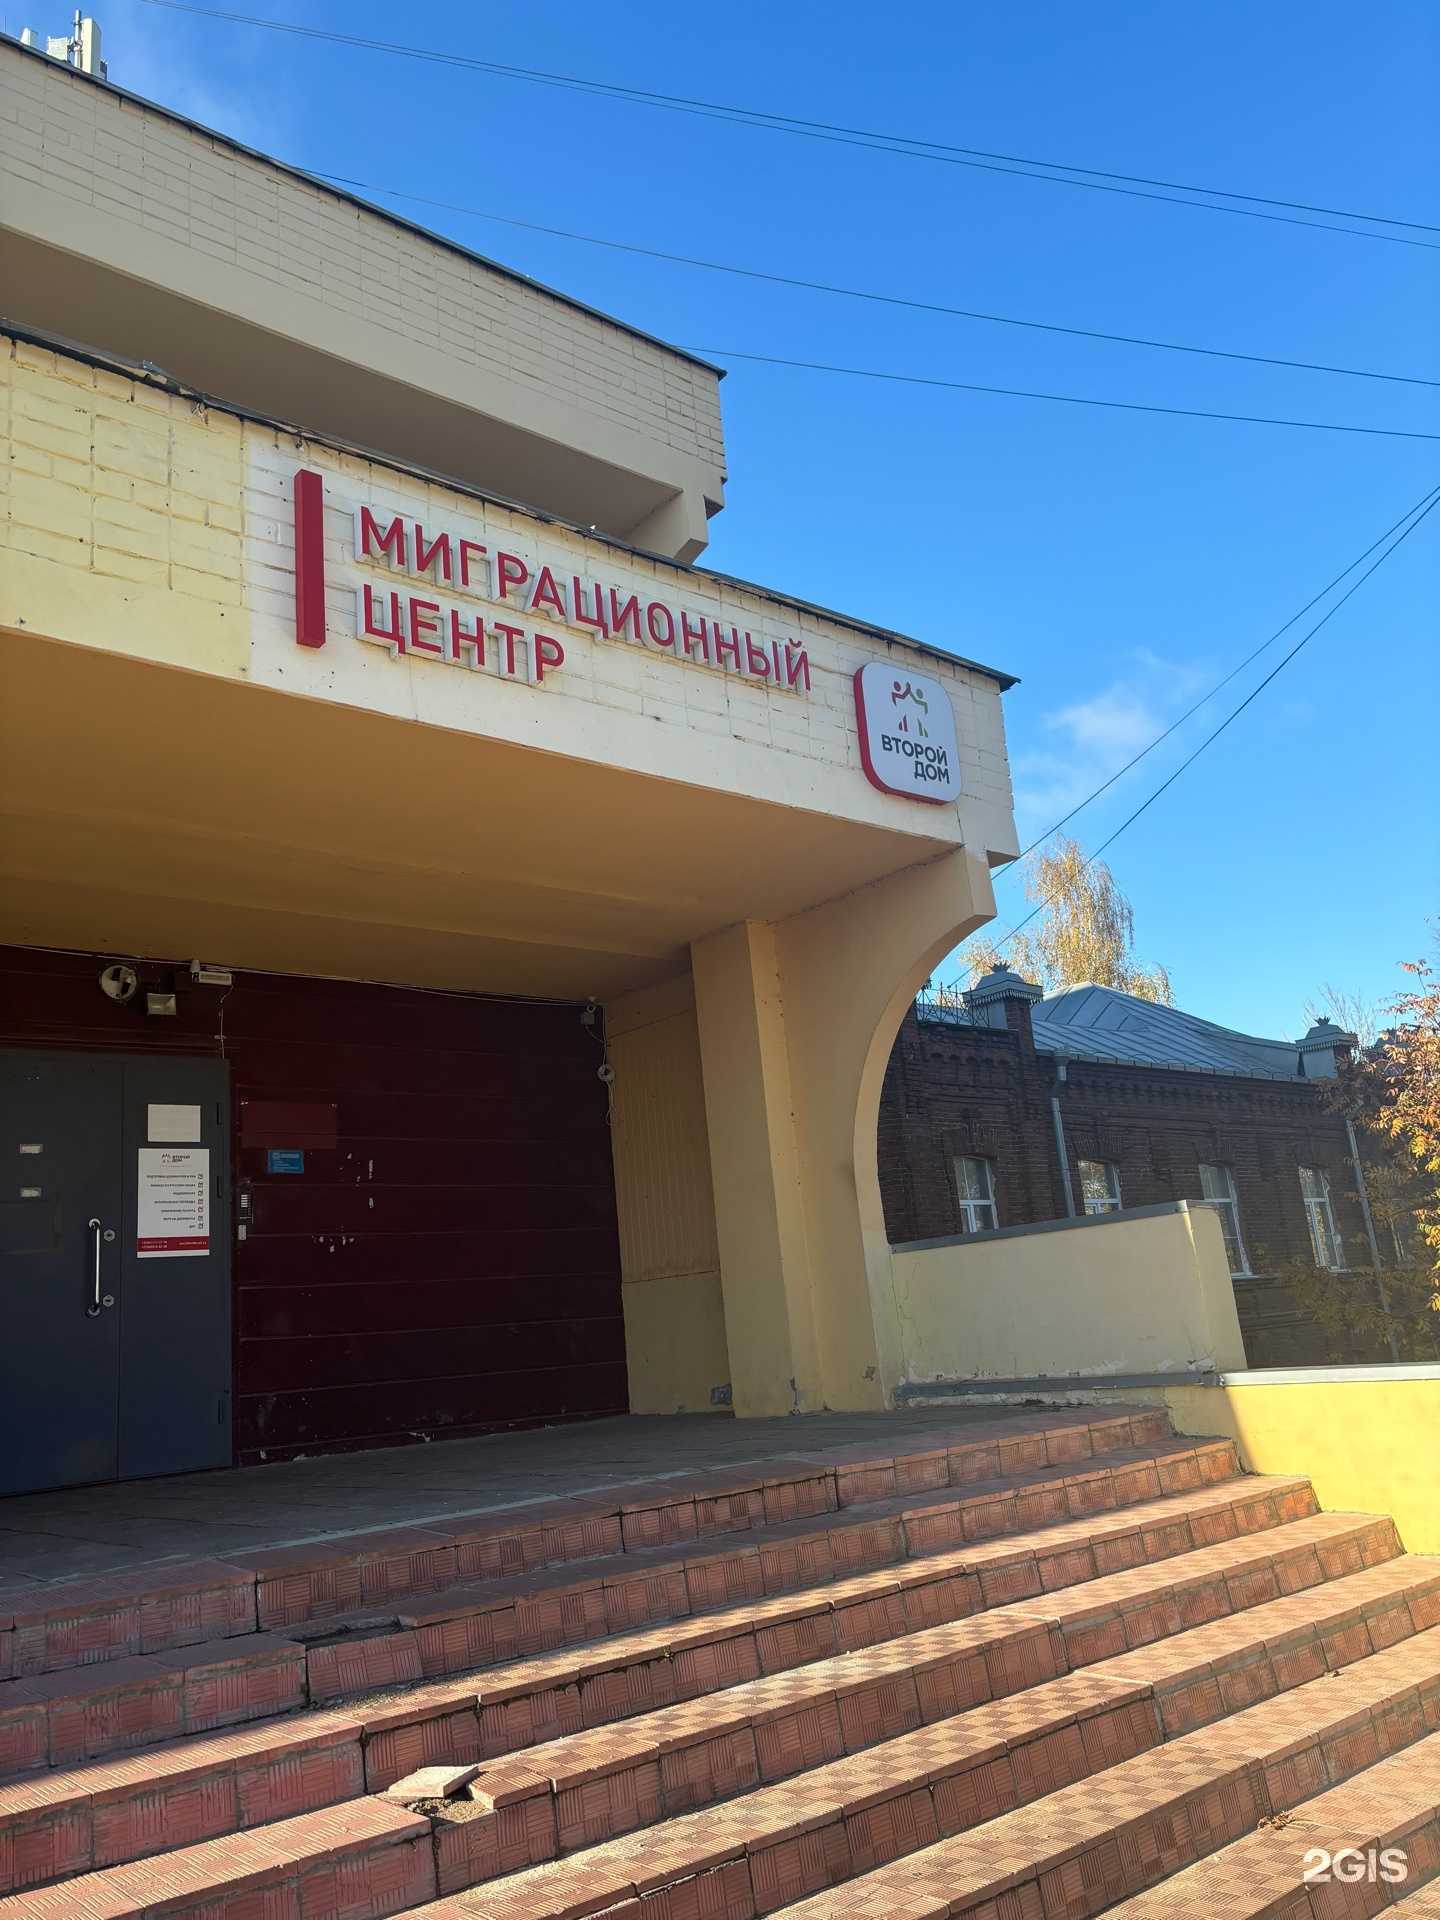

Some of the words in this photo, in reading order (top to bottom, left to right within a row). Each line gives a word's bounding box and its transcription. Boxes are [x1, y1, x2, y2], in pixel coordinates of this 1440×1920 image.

[360, 505, 811, 691] МИГРАЦИОННЫЙ
[362, 584, 565, 682] ЦЕНТР
[881, 734, 948, 766] ВТОРОЙ
[914, 760, 950, 784] ДОМ
